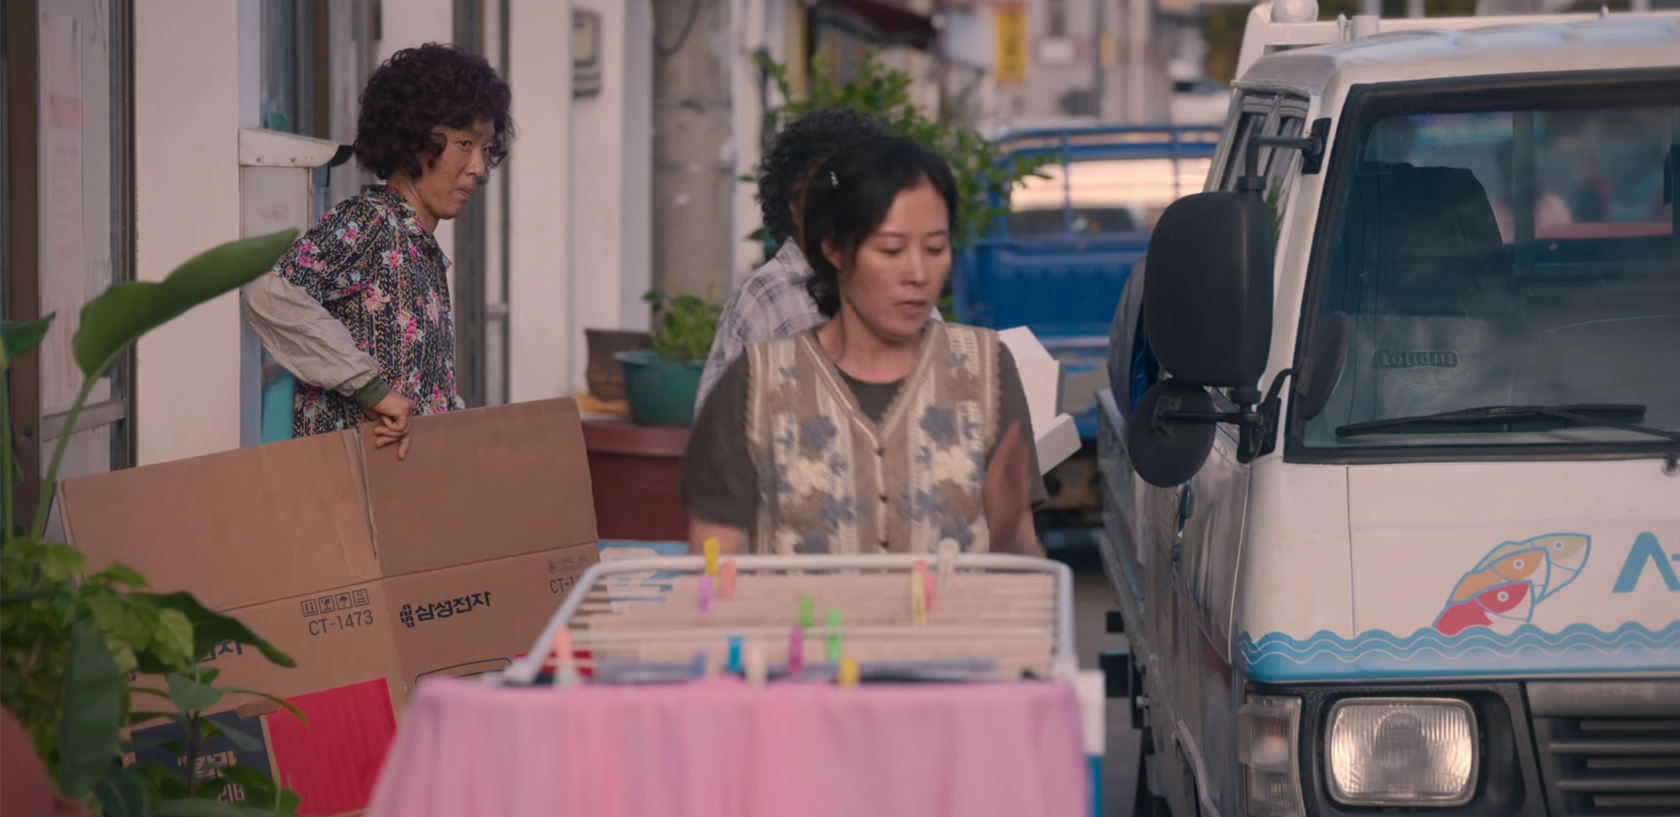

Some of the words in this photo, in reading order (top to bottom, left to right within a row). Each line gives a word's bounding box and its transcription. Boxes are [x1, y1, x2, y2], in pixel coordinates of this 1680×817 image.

[549, 575, 580, 594] CT-1
[415, 591, 491, 622] 삼성전자
[308, 609, 374, 636] CT-1473
